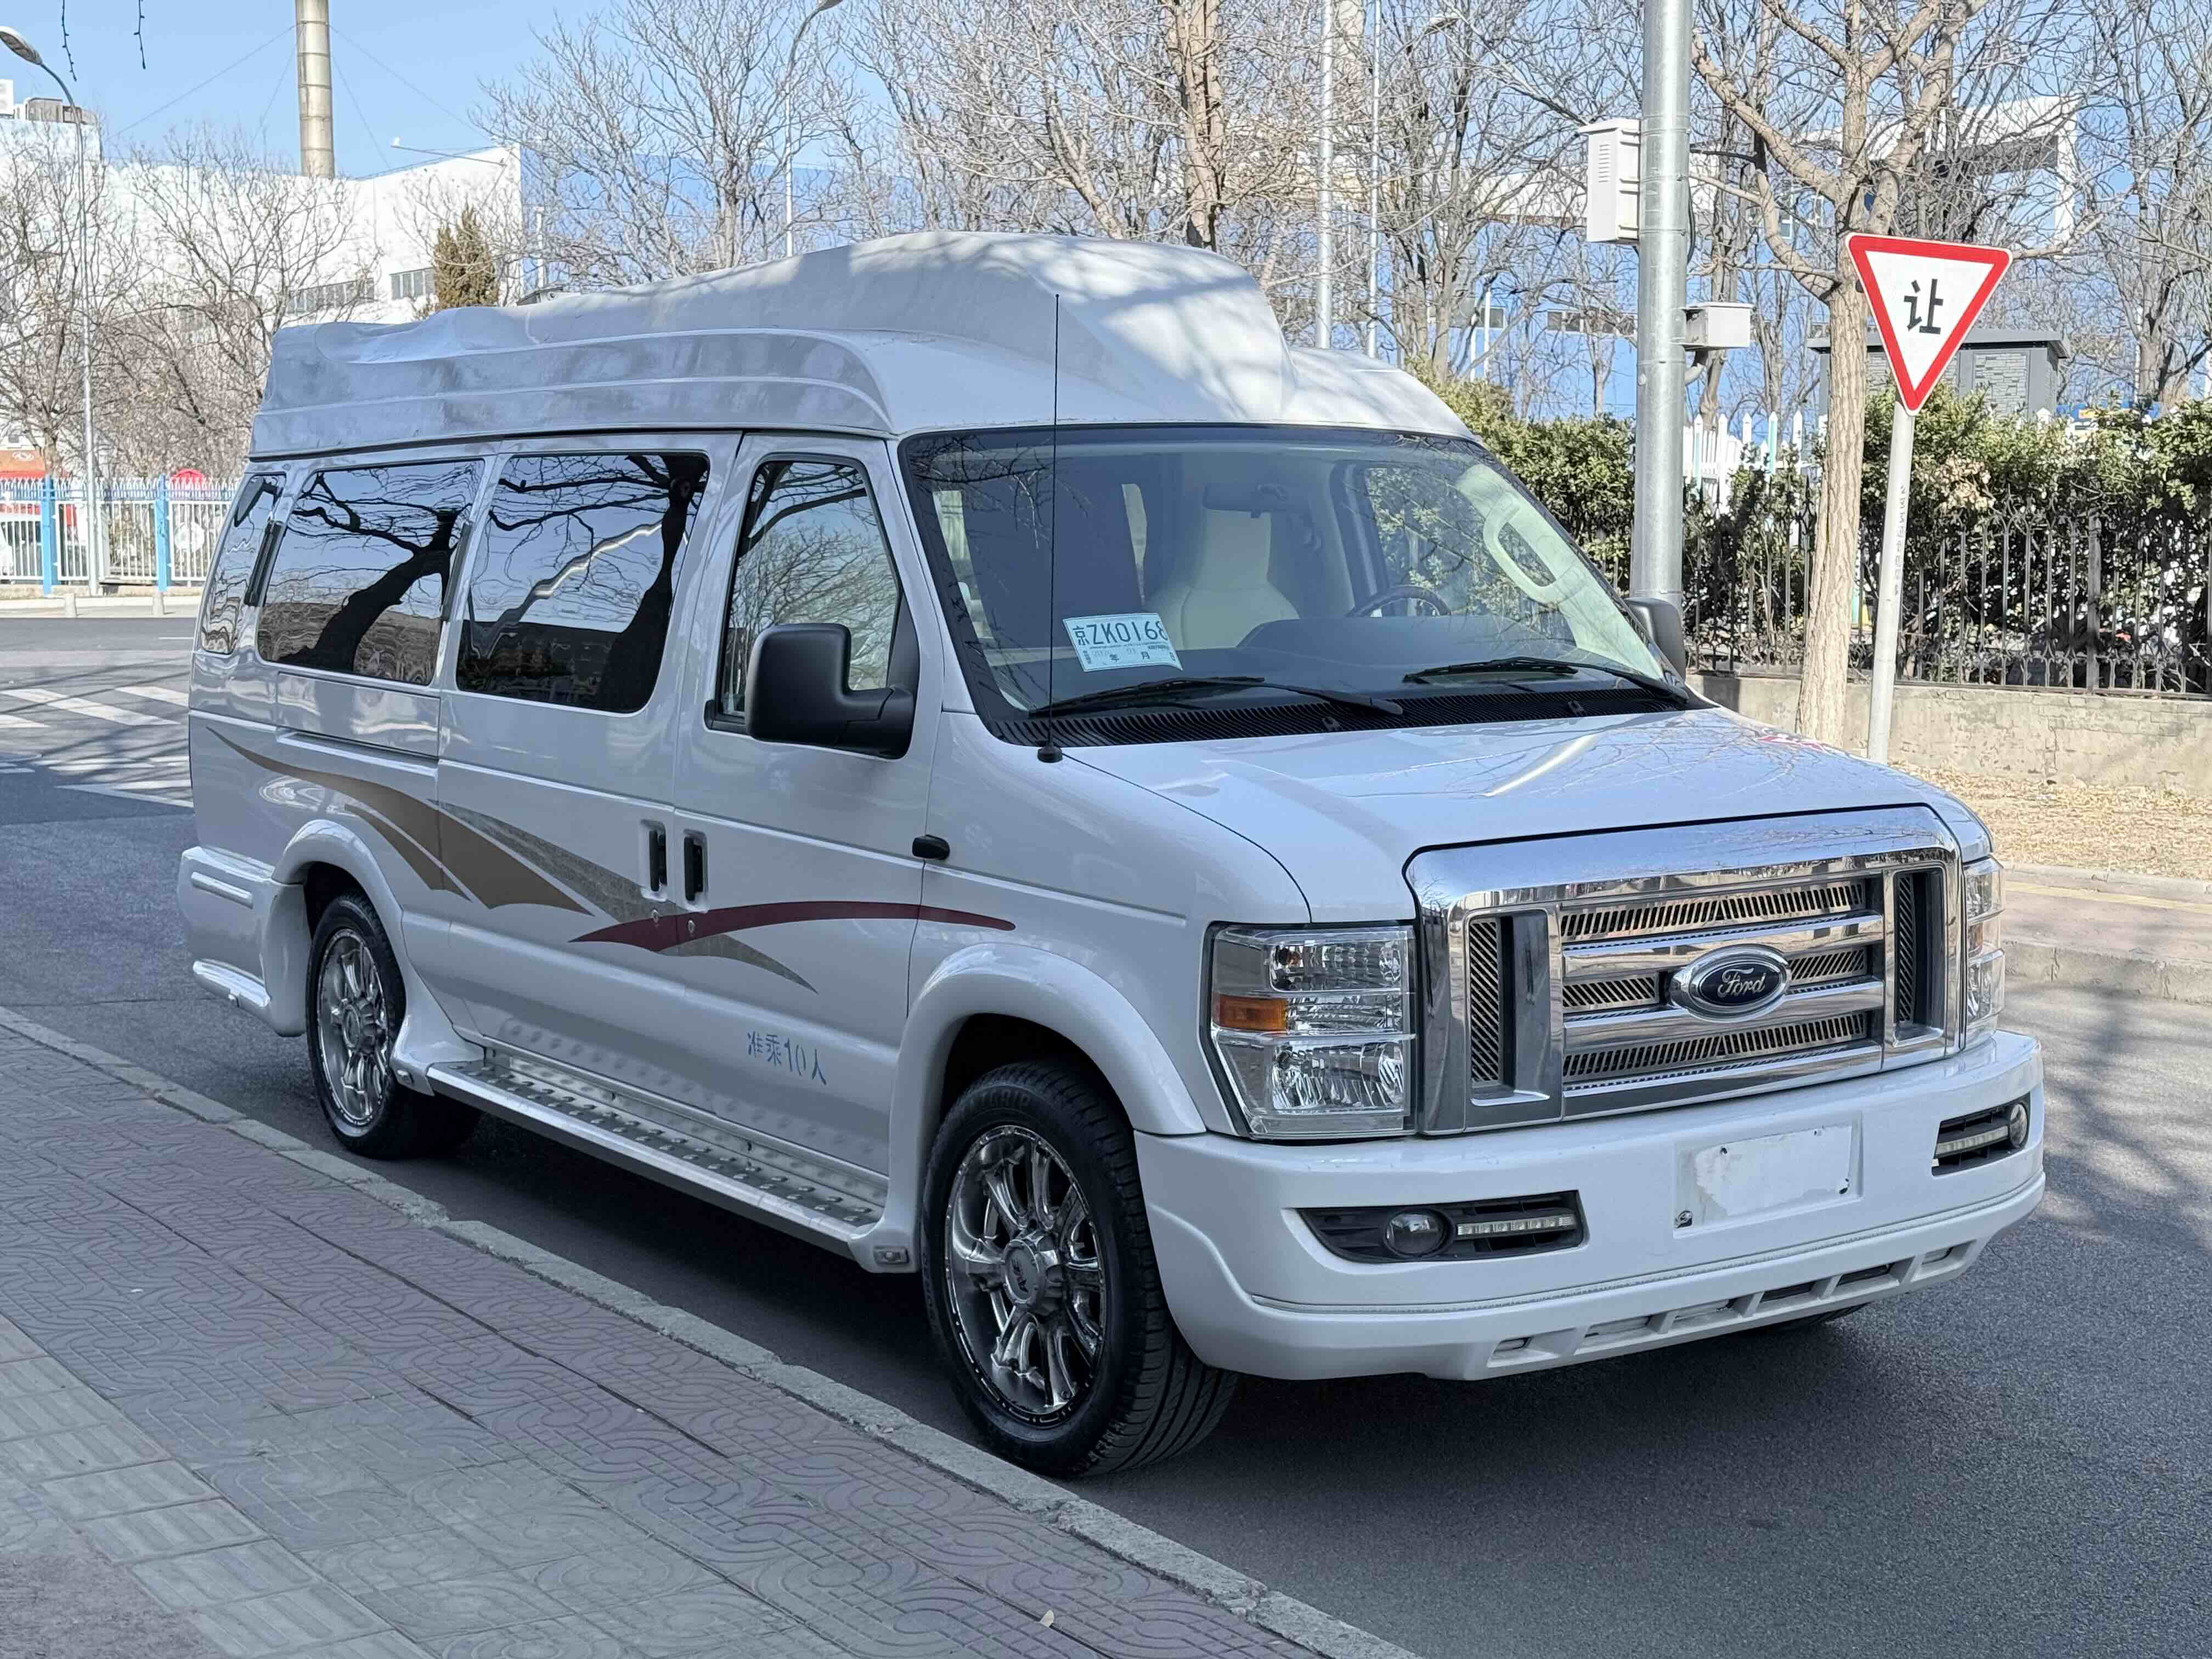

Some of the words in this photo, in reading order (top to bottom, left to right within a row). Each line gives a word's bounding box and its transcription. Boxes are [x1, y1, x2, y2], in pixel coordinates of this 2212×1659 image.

[1904, 279, 1944, 335] 让
[1718, 968, 1767, 998] Ford
[747, 1031, 827, 1085] 准乘10人
